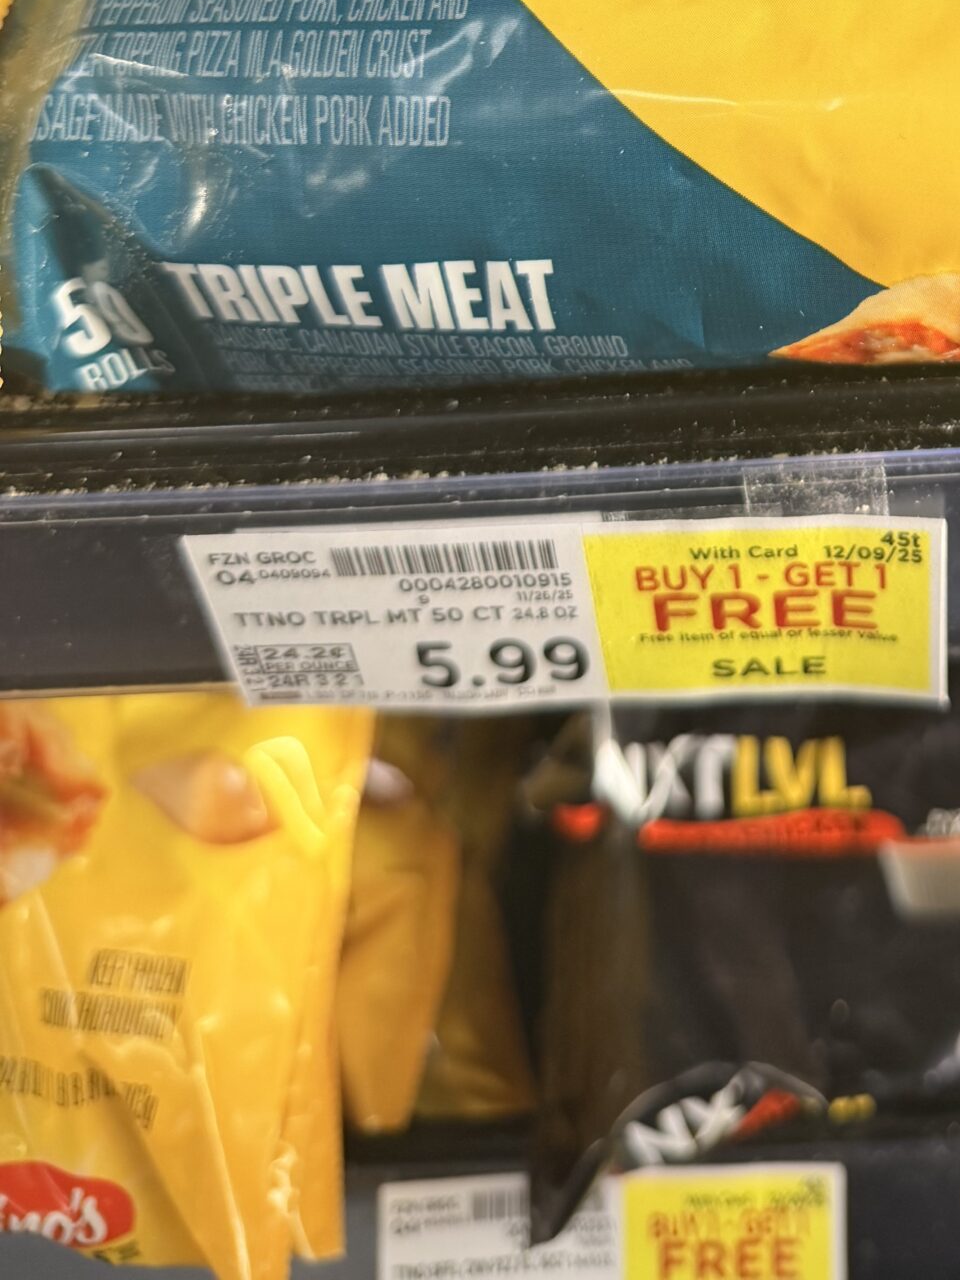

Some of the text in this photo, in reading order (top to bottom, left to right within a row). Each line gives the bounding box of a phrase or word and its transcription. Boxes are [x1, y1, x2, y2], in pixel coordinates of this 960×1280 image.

[187, 29, 243, 78] PIZZA
[286, 28, 363, 78] GOLDEN
[366, 27, 433, 80] CRUST
[166, 93, 215, 144] WITH
[221, 94, 309, 146] CHICKEN
[314, 94, 374, 145] PORK
[378, 94, 453, 147] ADDED
[160, 259, 556, 332] TRIPLE MEAT
[53, 276, 153, 358] 50
[298, 327, 404, 357] CANADIAN
[402, 332, 468, 358] STYLE
[467, 333, 546, 359] BACON,
[543, 334, 629, 358] GROUND
[80, 346, 176, 391] ROLLS
[208, 550, 318, 566] FZN GROC
[689, 543, 923, 564] With Card 12/09/25
[400, 573, 573, 593] 0004280010915
[634, 564, 715, 592] BUY
[728, 564, 742, 589] 1
[784, 562, 862, 587] GET
[874, 564, 888, 589] 1
[233, 610, 305, 627] TTNO
[313, 609, 381, 626] TRPL
[386, 607, 424, 623] MT
[432, 607, 465, 622] 50
[472, 605, 504, 621] CT
[554, 605, 579, 619] OZ
[653, 590, 879, 632] FREE
[416, 636, 591, 689] 5.99
[711, 656, 828, 677] SALE
[656, 1238, 800, 1280] FREE
